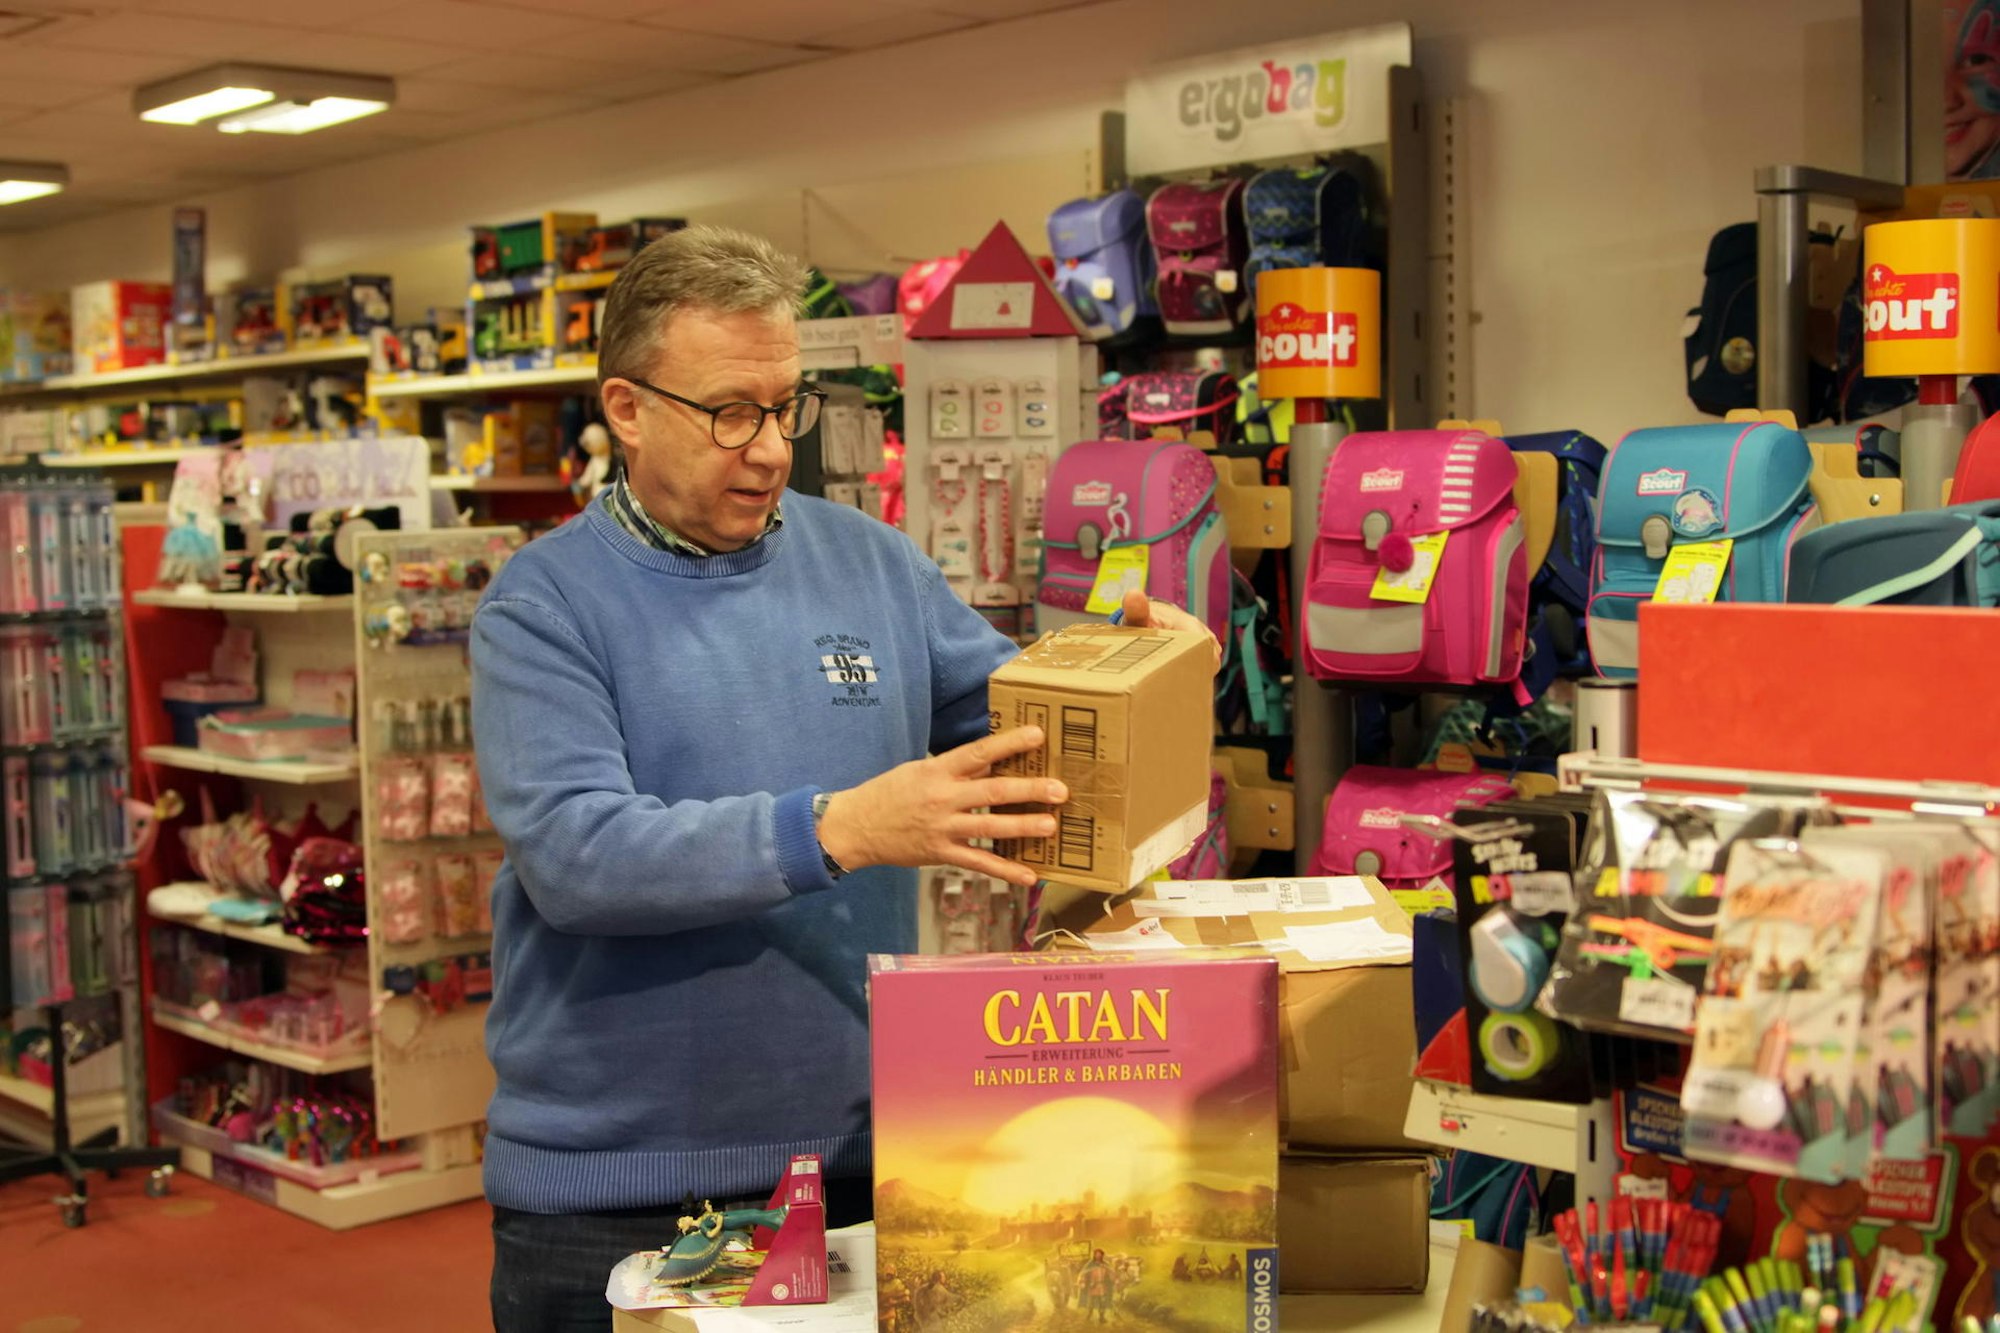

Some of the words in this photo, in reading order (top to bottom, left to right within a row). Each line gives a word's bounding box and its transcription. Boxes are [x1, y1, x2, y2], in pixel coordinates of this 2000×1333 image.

[1179, 57, 1346, 141] ergobag
[1256, 324, 1356, 363] cout
[1363, 474, 1401, 488] Scout
[1641, 476, 1681, 491] Scout
[832, 651, 867, 683] 95
[1043, 973, 1071, 982] KLAUS
[983, 988, 1170, 1047] CATAN
[1032, 1048, 1124, 1062] ERWEITERUNG
[974, 1065, 1060, 1086] HÄNDLER
[1064, 1068, 1076, 1083] &
[1082, 1063, 1183, 1082] BARBAREN
[1253, 1257, 1272, 1333] OSMOS
